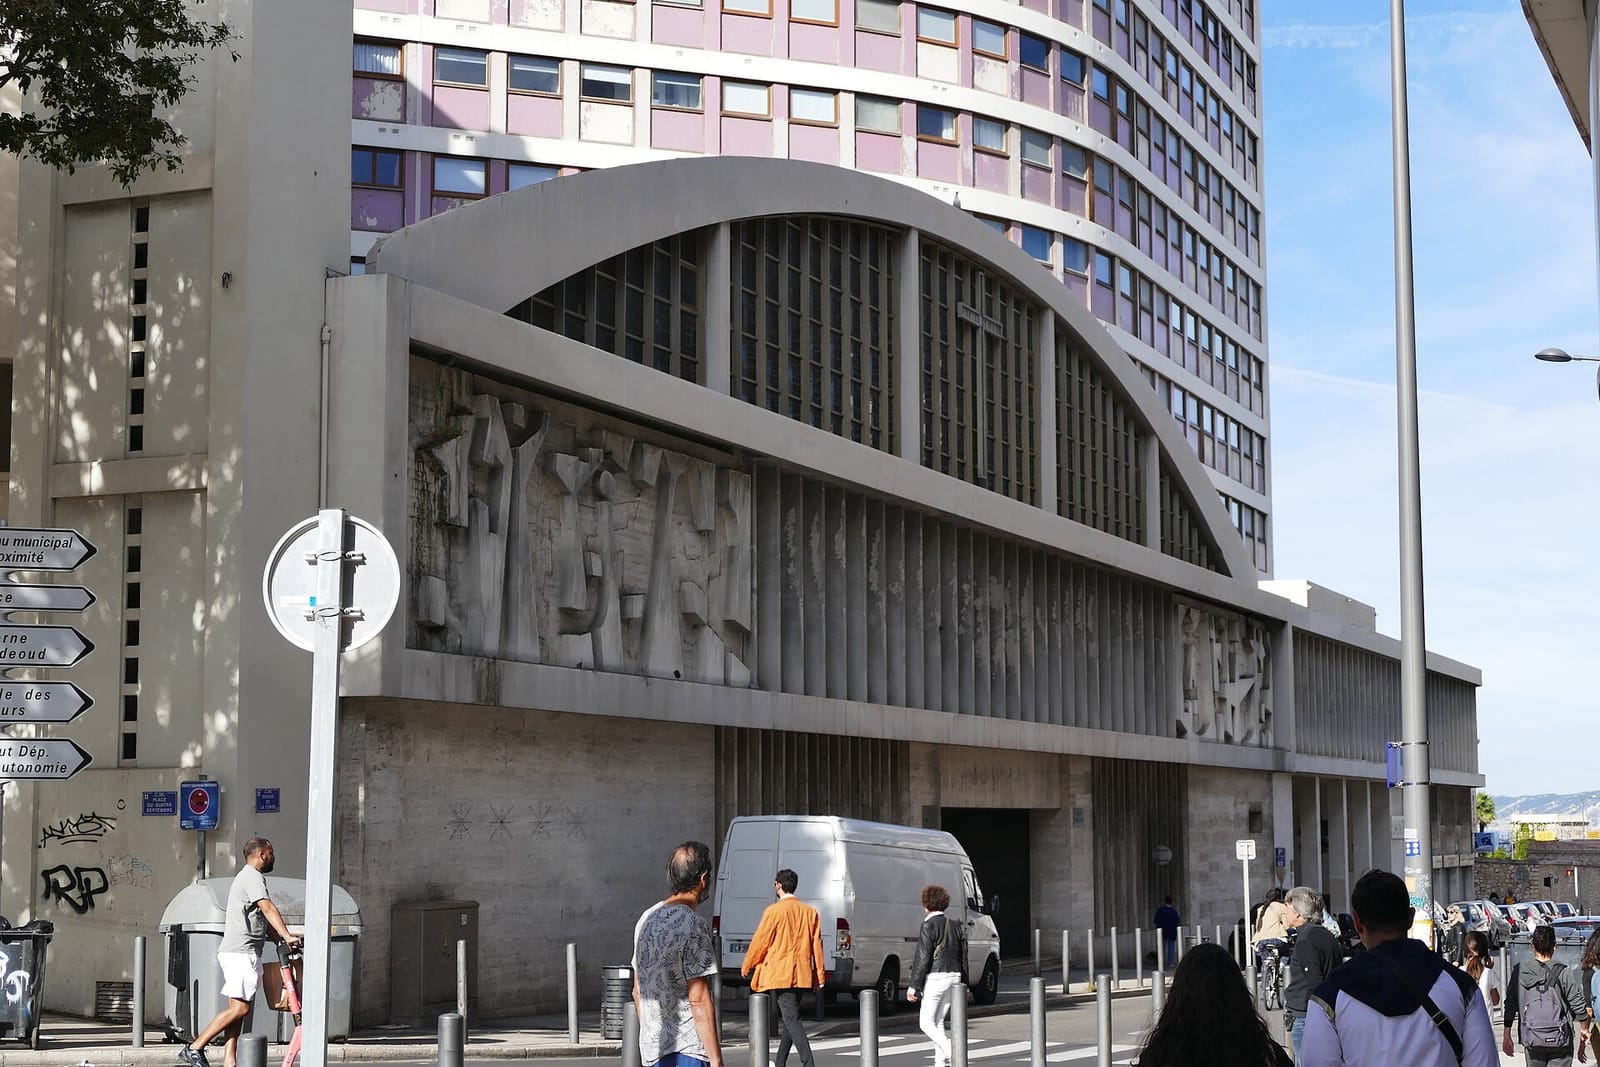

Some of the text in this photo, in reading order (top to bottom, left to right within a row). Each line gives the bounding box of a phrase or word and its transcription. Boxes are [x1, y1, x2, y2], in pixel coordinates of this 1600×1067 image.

[13, 536, 73, 551] municipal
[0, 634, 28, 644] rne
[0, 647, 46, 660] deoud
[25, 688, 51, 701] des
[1, 706, 26, 716] urs
[19, 745, 49, 760] Dép.
[2, 761, 67, 773] utonomie
